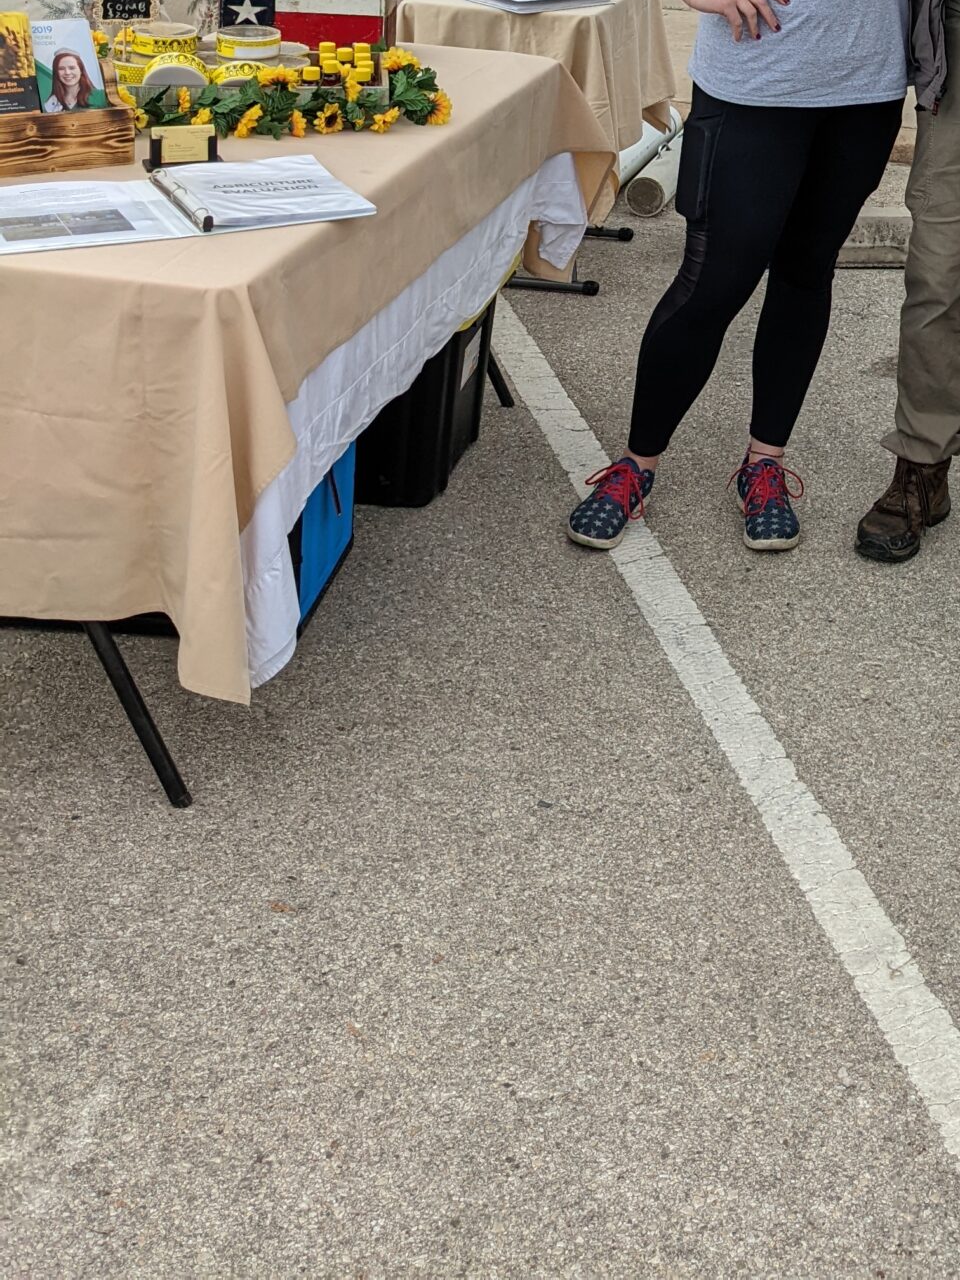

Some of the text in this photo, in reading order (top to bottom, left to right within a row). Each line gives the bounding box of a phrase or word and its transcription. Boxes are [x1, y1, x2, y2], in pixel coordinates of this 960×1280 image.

[32, 25, 53, 34] 2019
[212, 177, 315, 190] AGRICULTURE
[221, 184, 319, 195] EVALUATION
